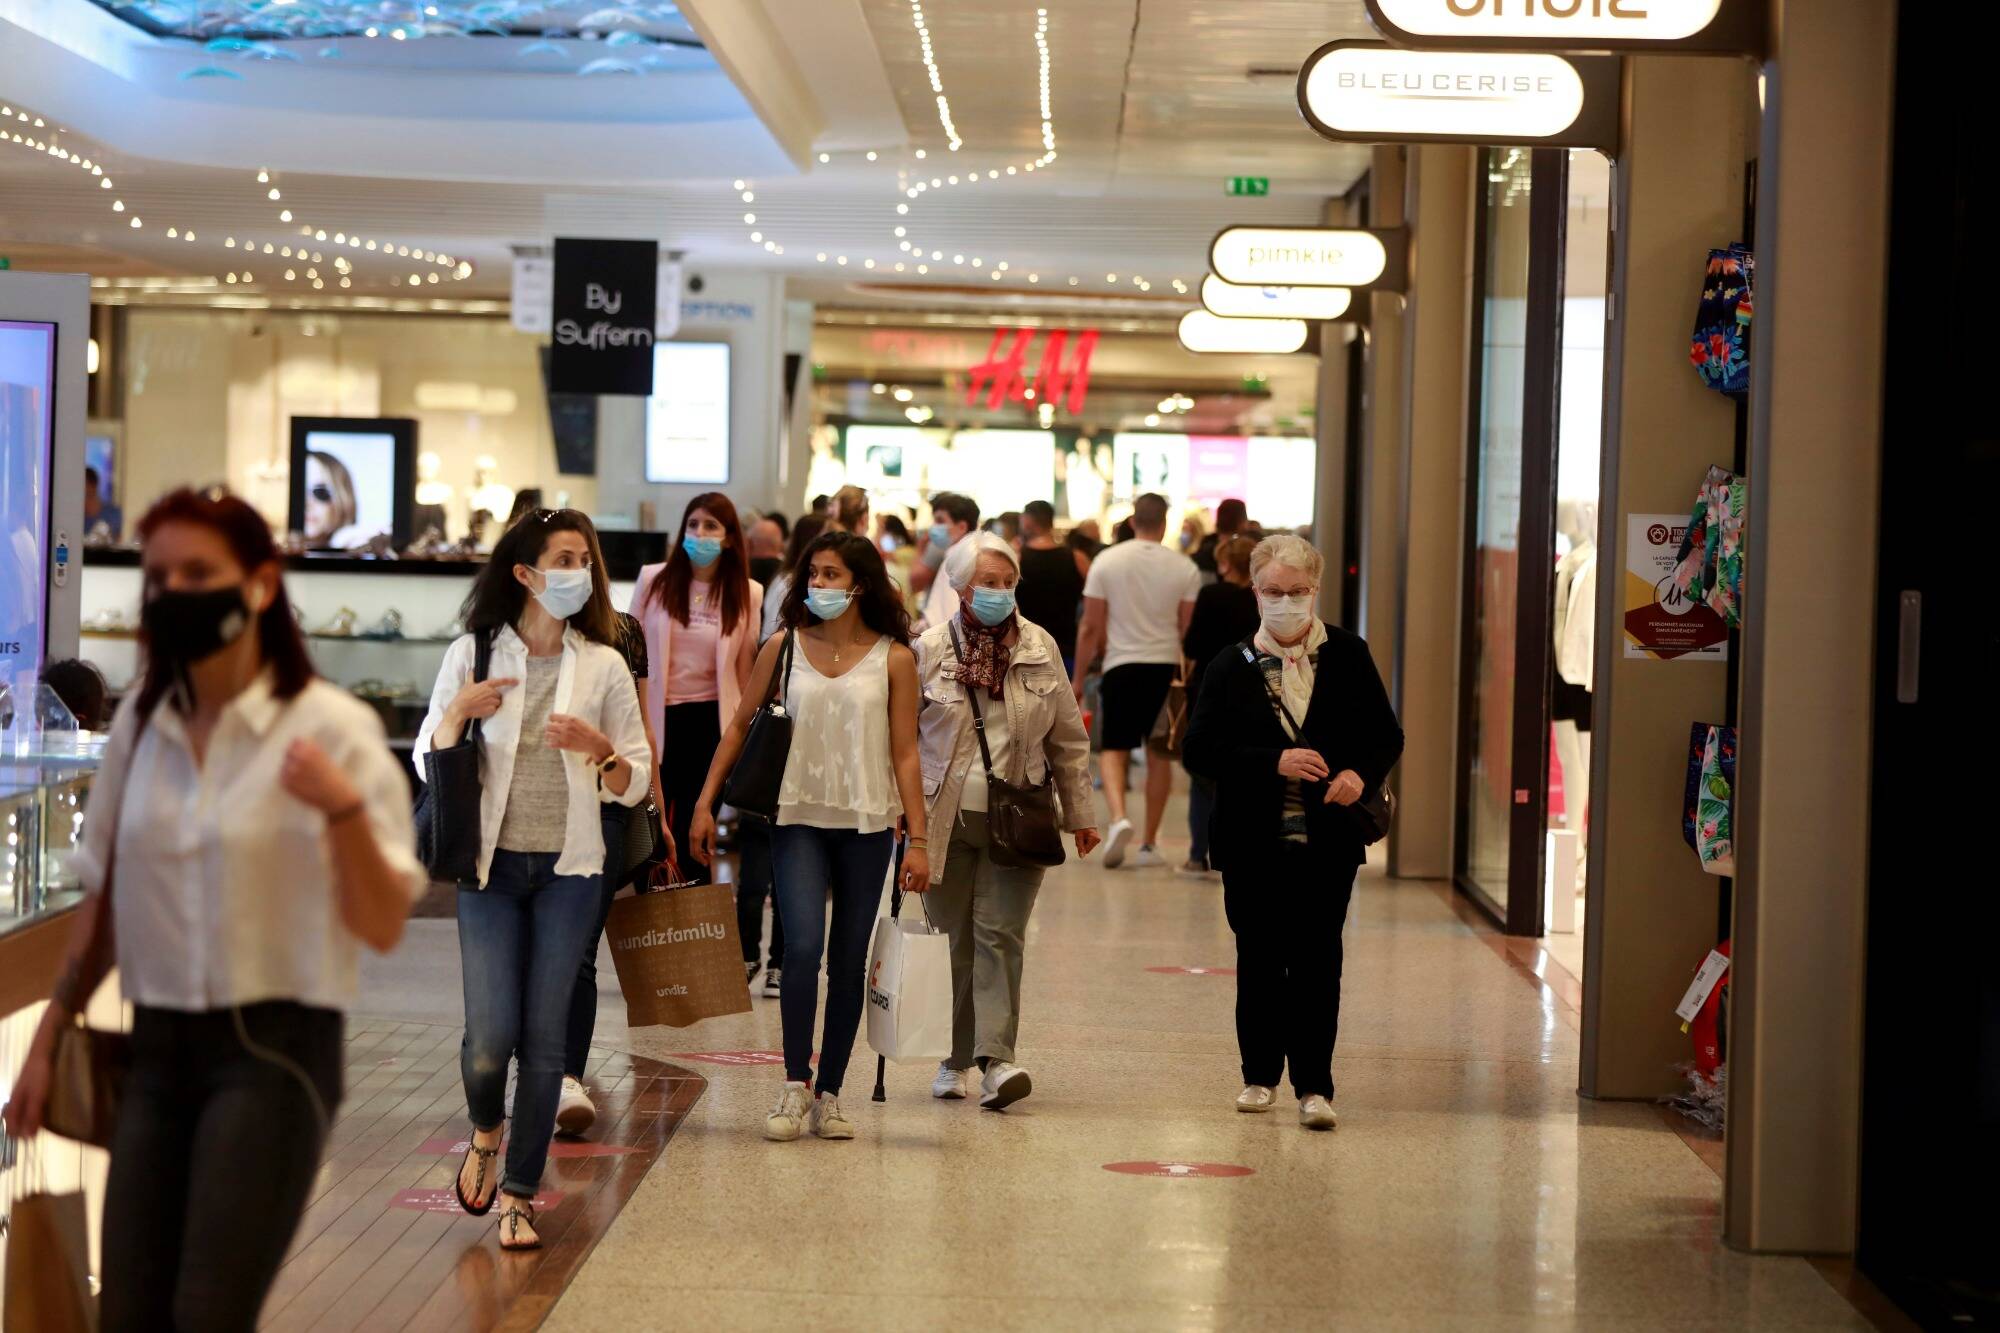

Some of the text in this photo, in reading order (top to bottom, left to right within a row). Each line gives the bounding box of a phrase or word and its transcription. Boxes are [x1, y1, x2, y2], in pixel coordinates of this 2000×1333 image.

[1338, 72, 1553, 93] BLEU CERISE
[1249, 246, 1344, 266] pimkie
[585, 282, 622, 315] By
[555, 318, 653, 350] Suffern
[655, 983, 689, 998] undiz
